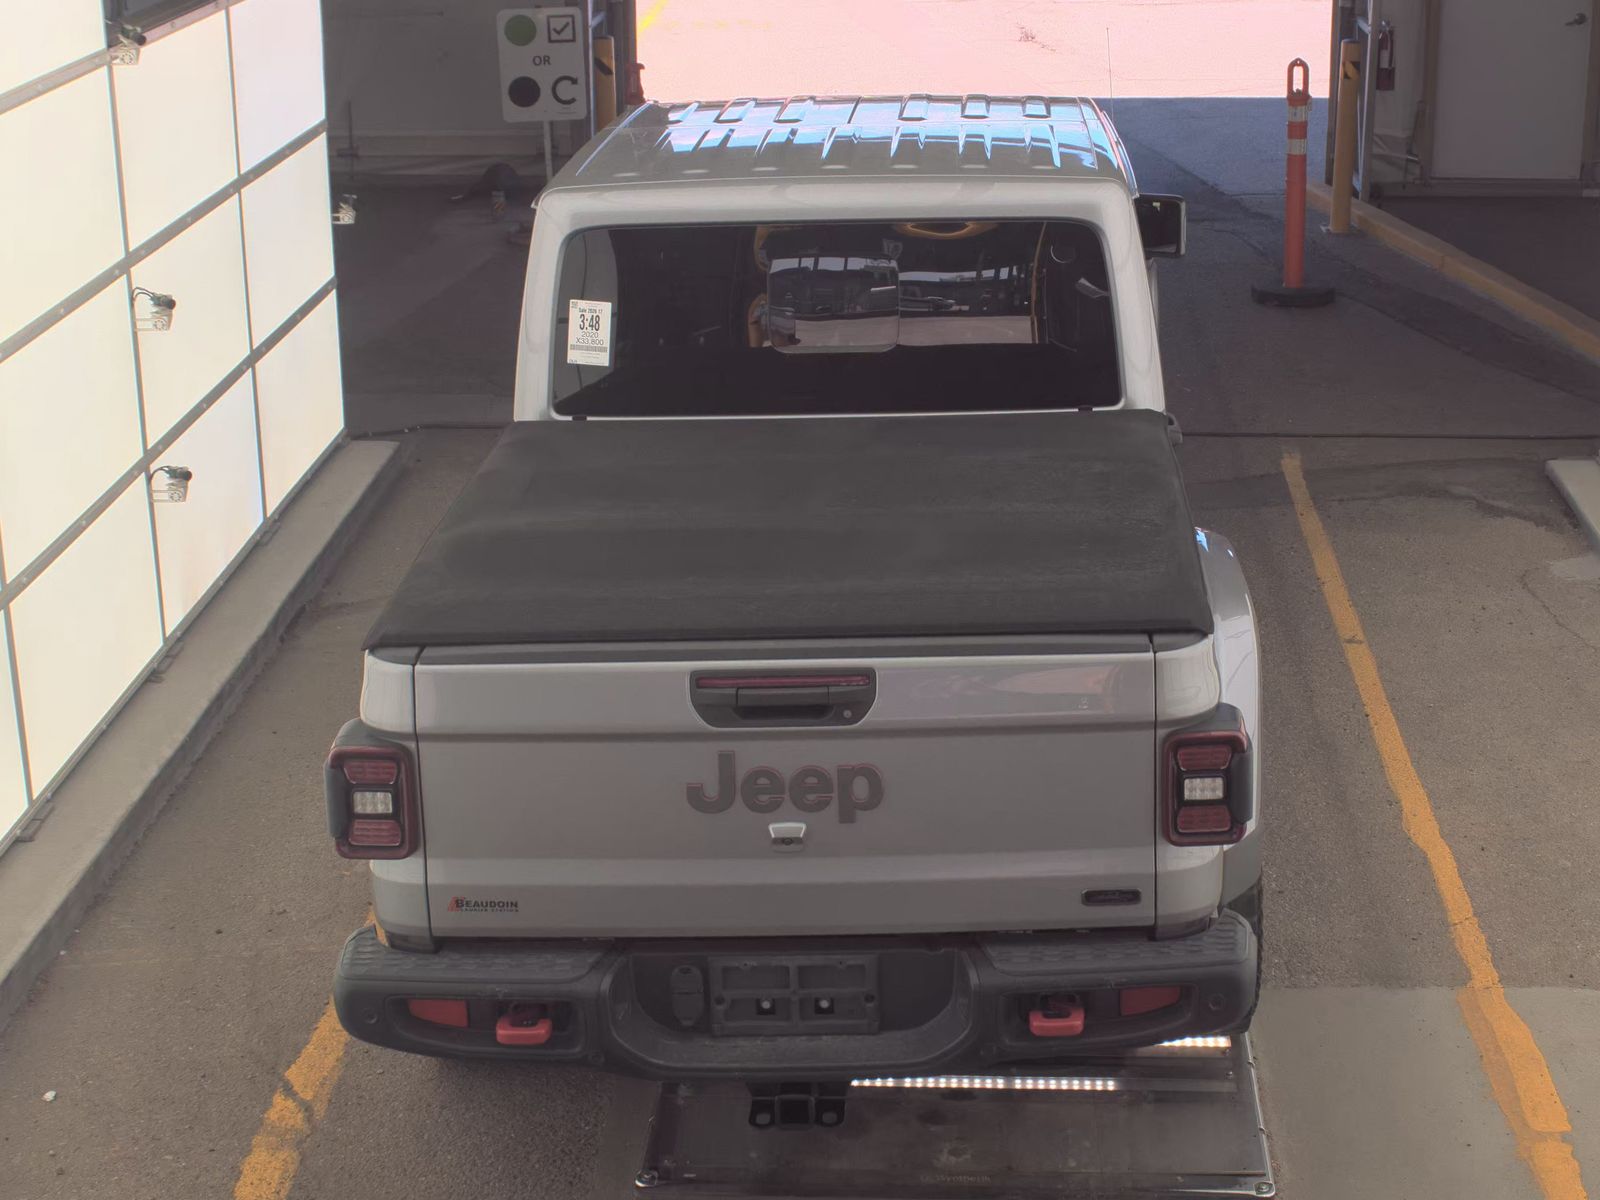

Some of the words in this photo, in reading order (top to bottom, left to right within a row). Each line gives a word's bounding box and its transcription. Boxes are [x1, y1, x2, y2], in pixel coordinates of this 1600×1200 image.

[532, 55, 551, 66] OR
[579, 314, 601, 331] 3:48
[686, 750, 884, 824] Jeep
[455, 898, 518, 908] BEAUDOIN
